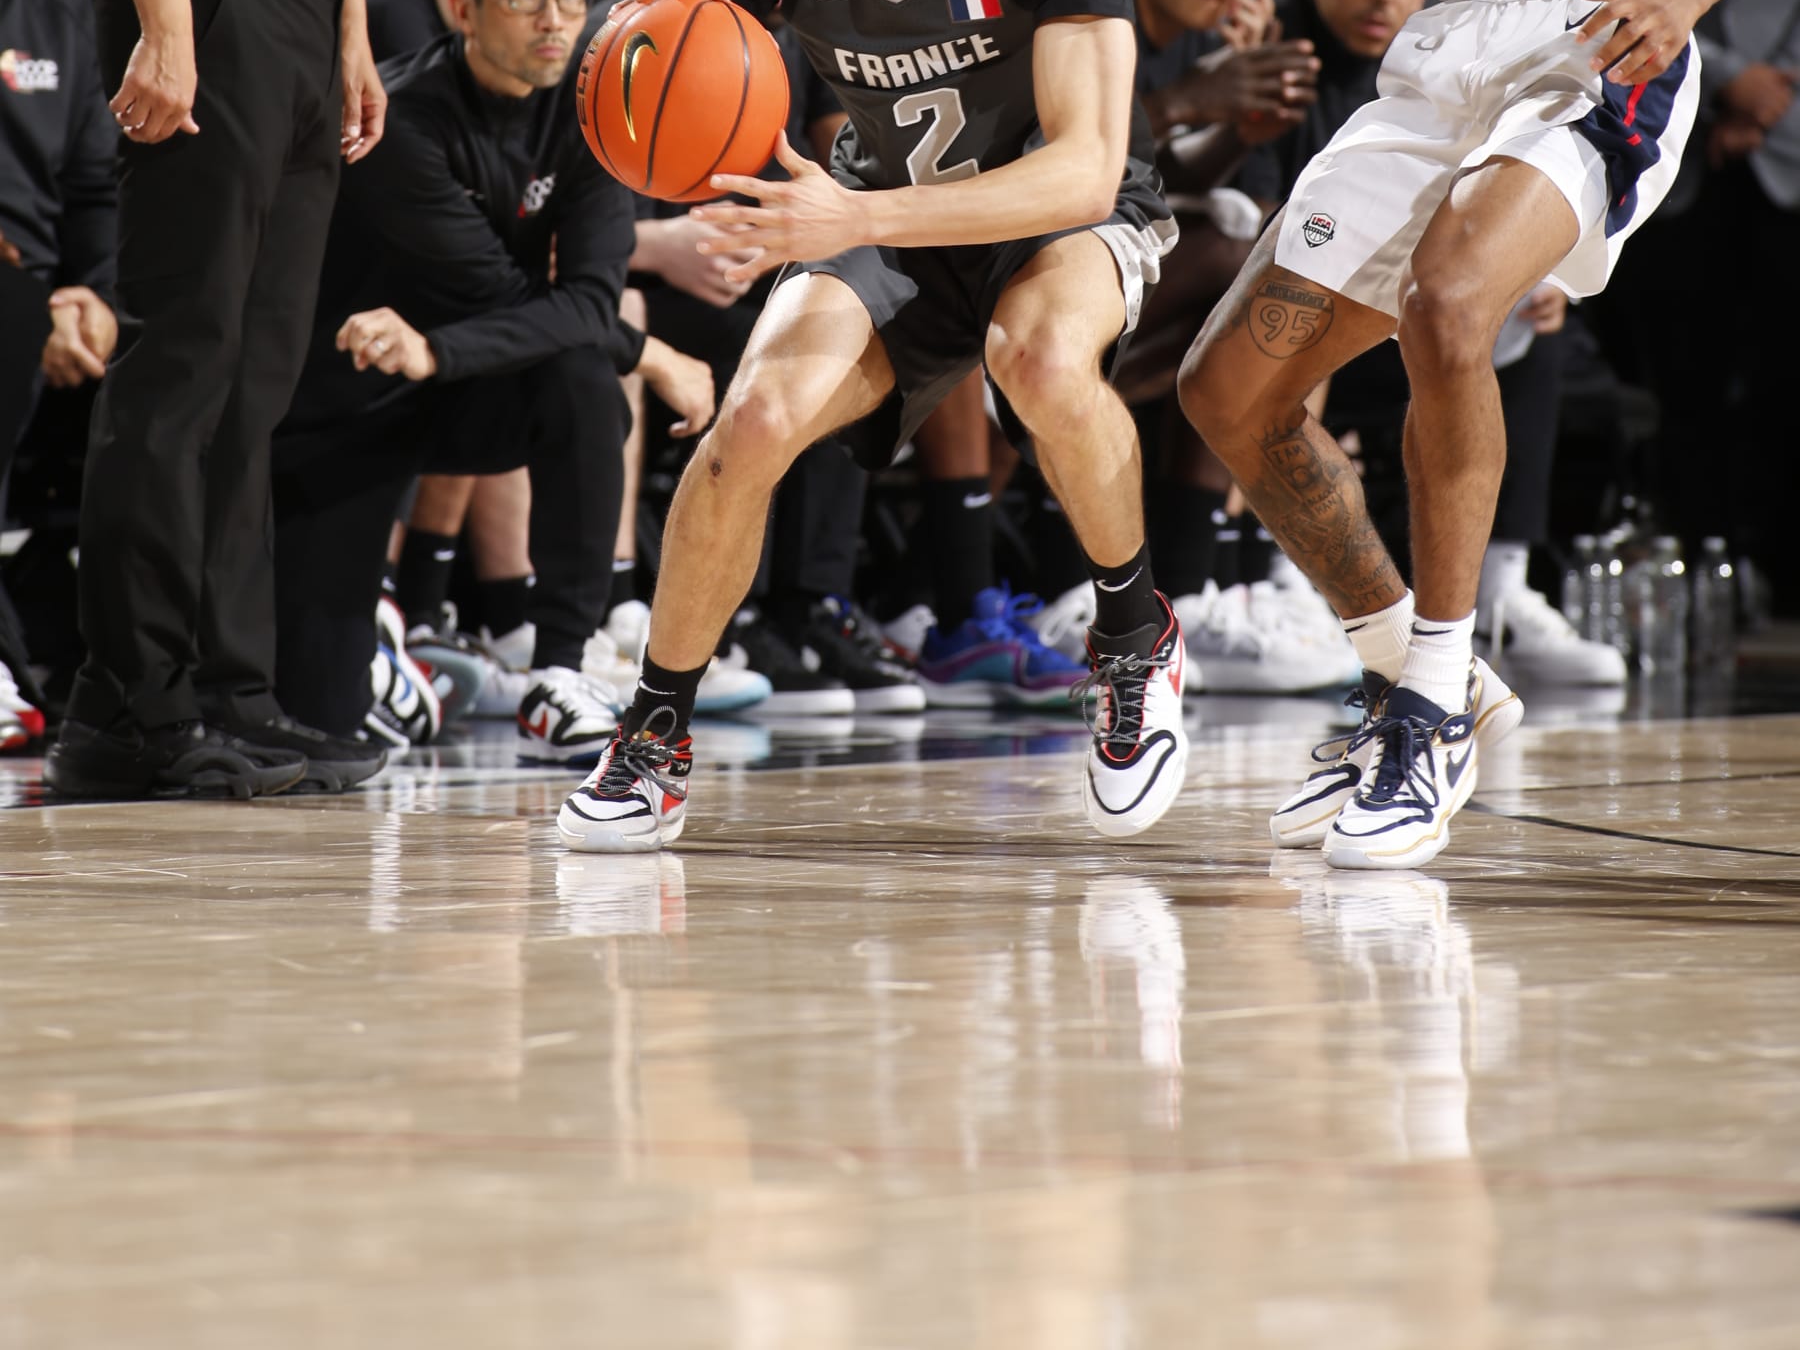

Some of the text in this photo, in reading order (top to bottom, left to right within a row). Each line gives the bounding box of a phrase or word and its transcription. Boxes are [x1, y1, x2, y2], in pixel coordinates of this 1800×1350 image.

[834, 33, 1001, 89] FRANCE
[892, 87, 980, 187] 2
[1311, 216, 1332, 232] USA
[1259, 304, 1319, 345] 95
